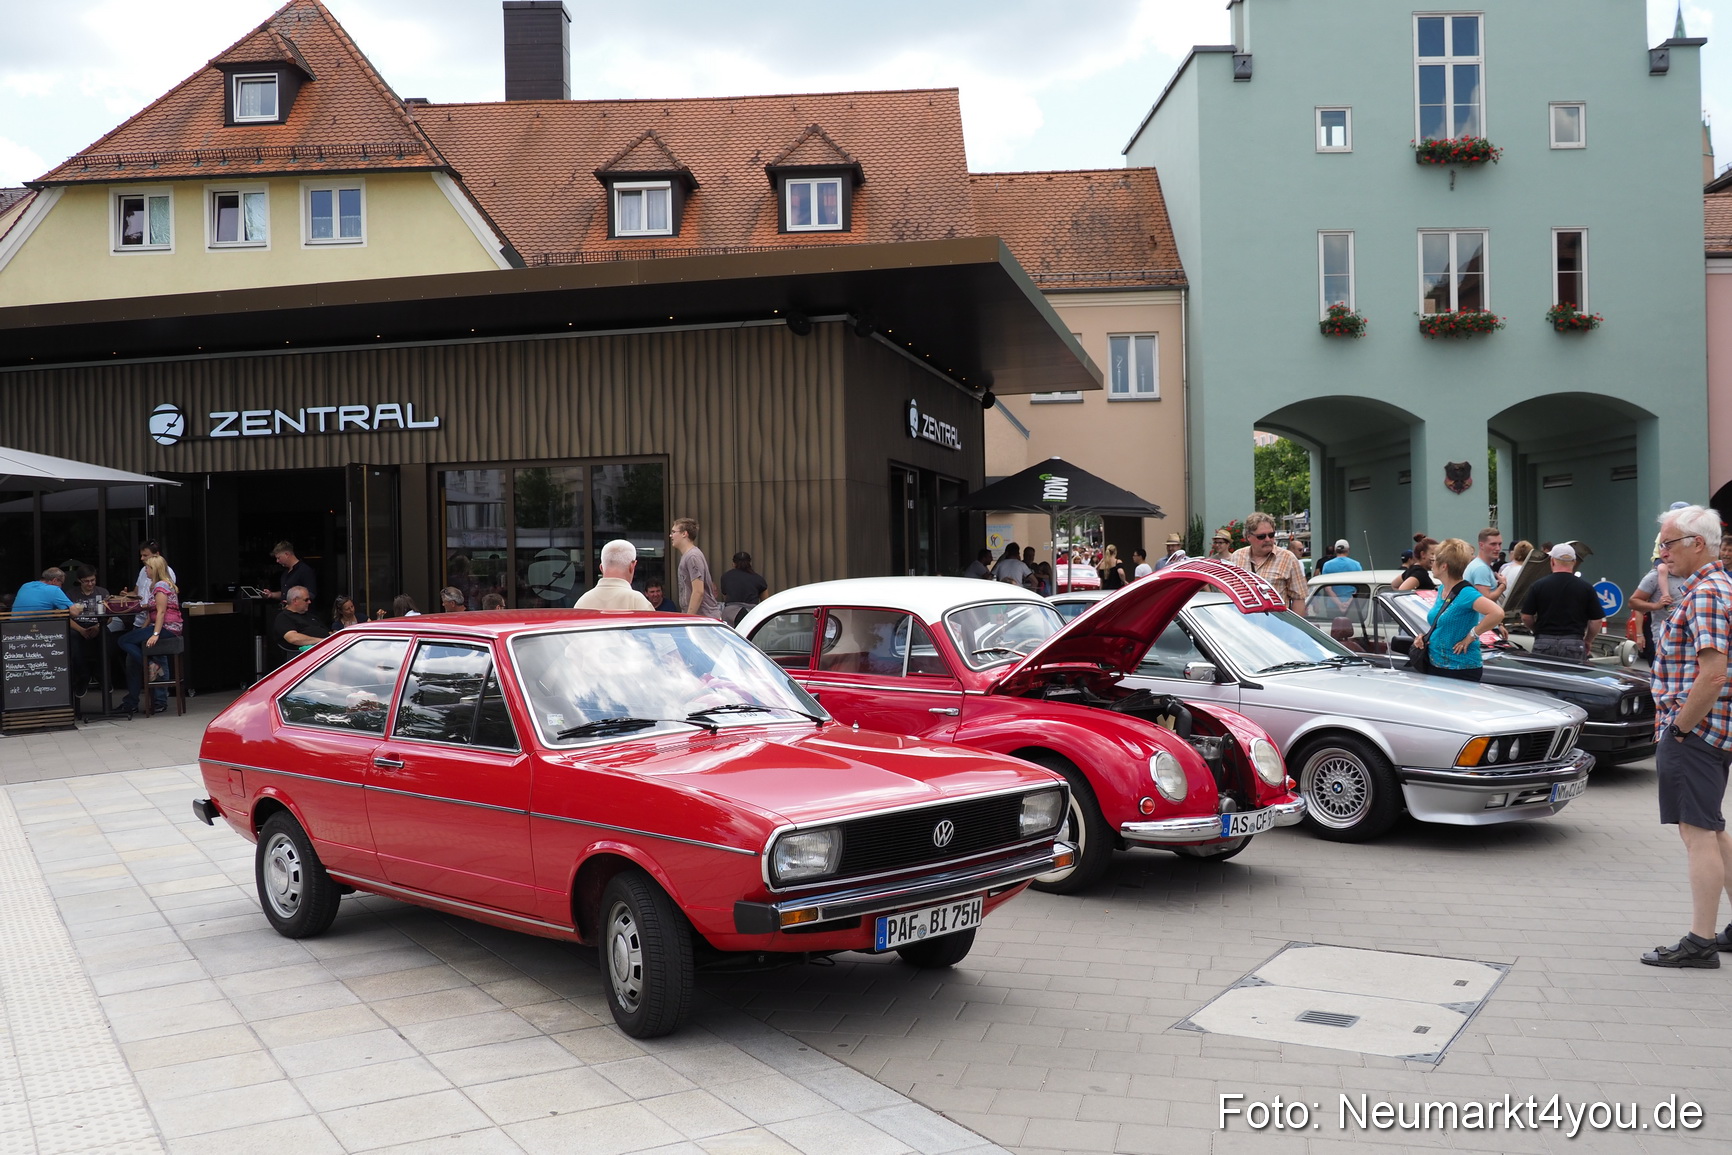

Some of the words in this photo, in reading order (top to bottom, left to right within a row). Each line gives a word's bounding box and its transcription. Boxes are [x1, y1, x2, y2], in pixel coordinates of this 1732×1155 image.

[209, 402, 440, 438] ZENTRAL
[922, 413, 962, 450] ZENTRAL
[1231, 815, 1249, 834] AS
[1256, 811, 1268, 831] CF
[888, 914, 919, 944] PAF
[930, 907, 948, 934] BI
[952, 900, 981, 929] 75H
